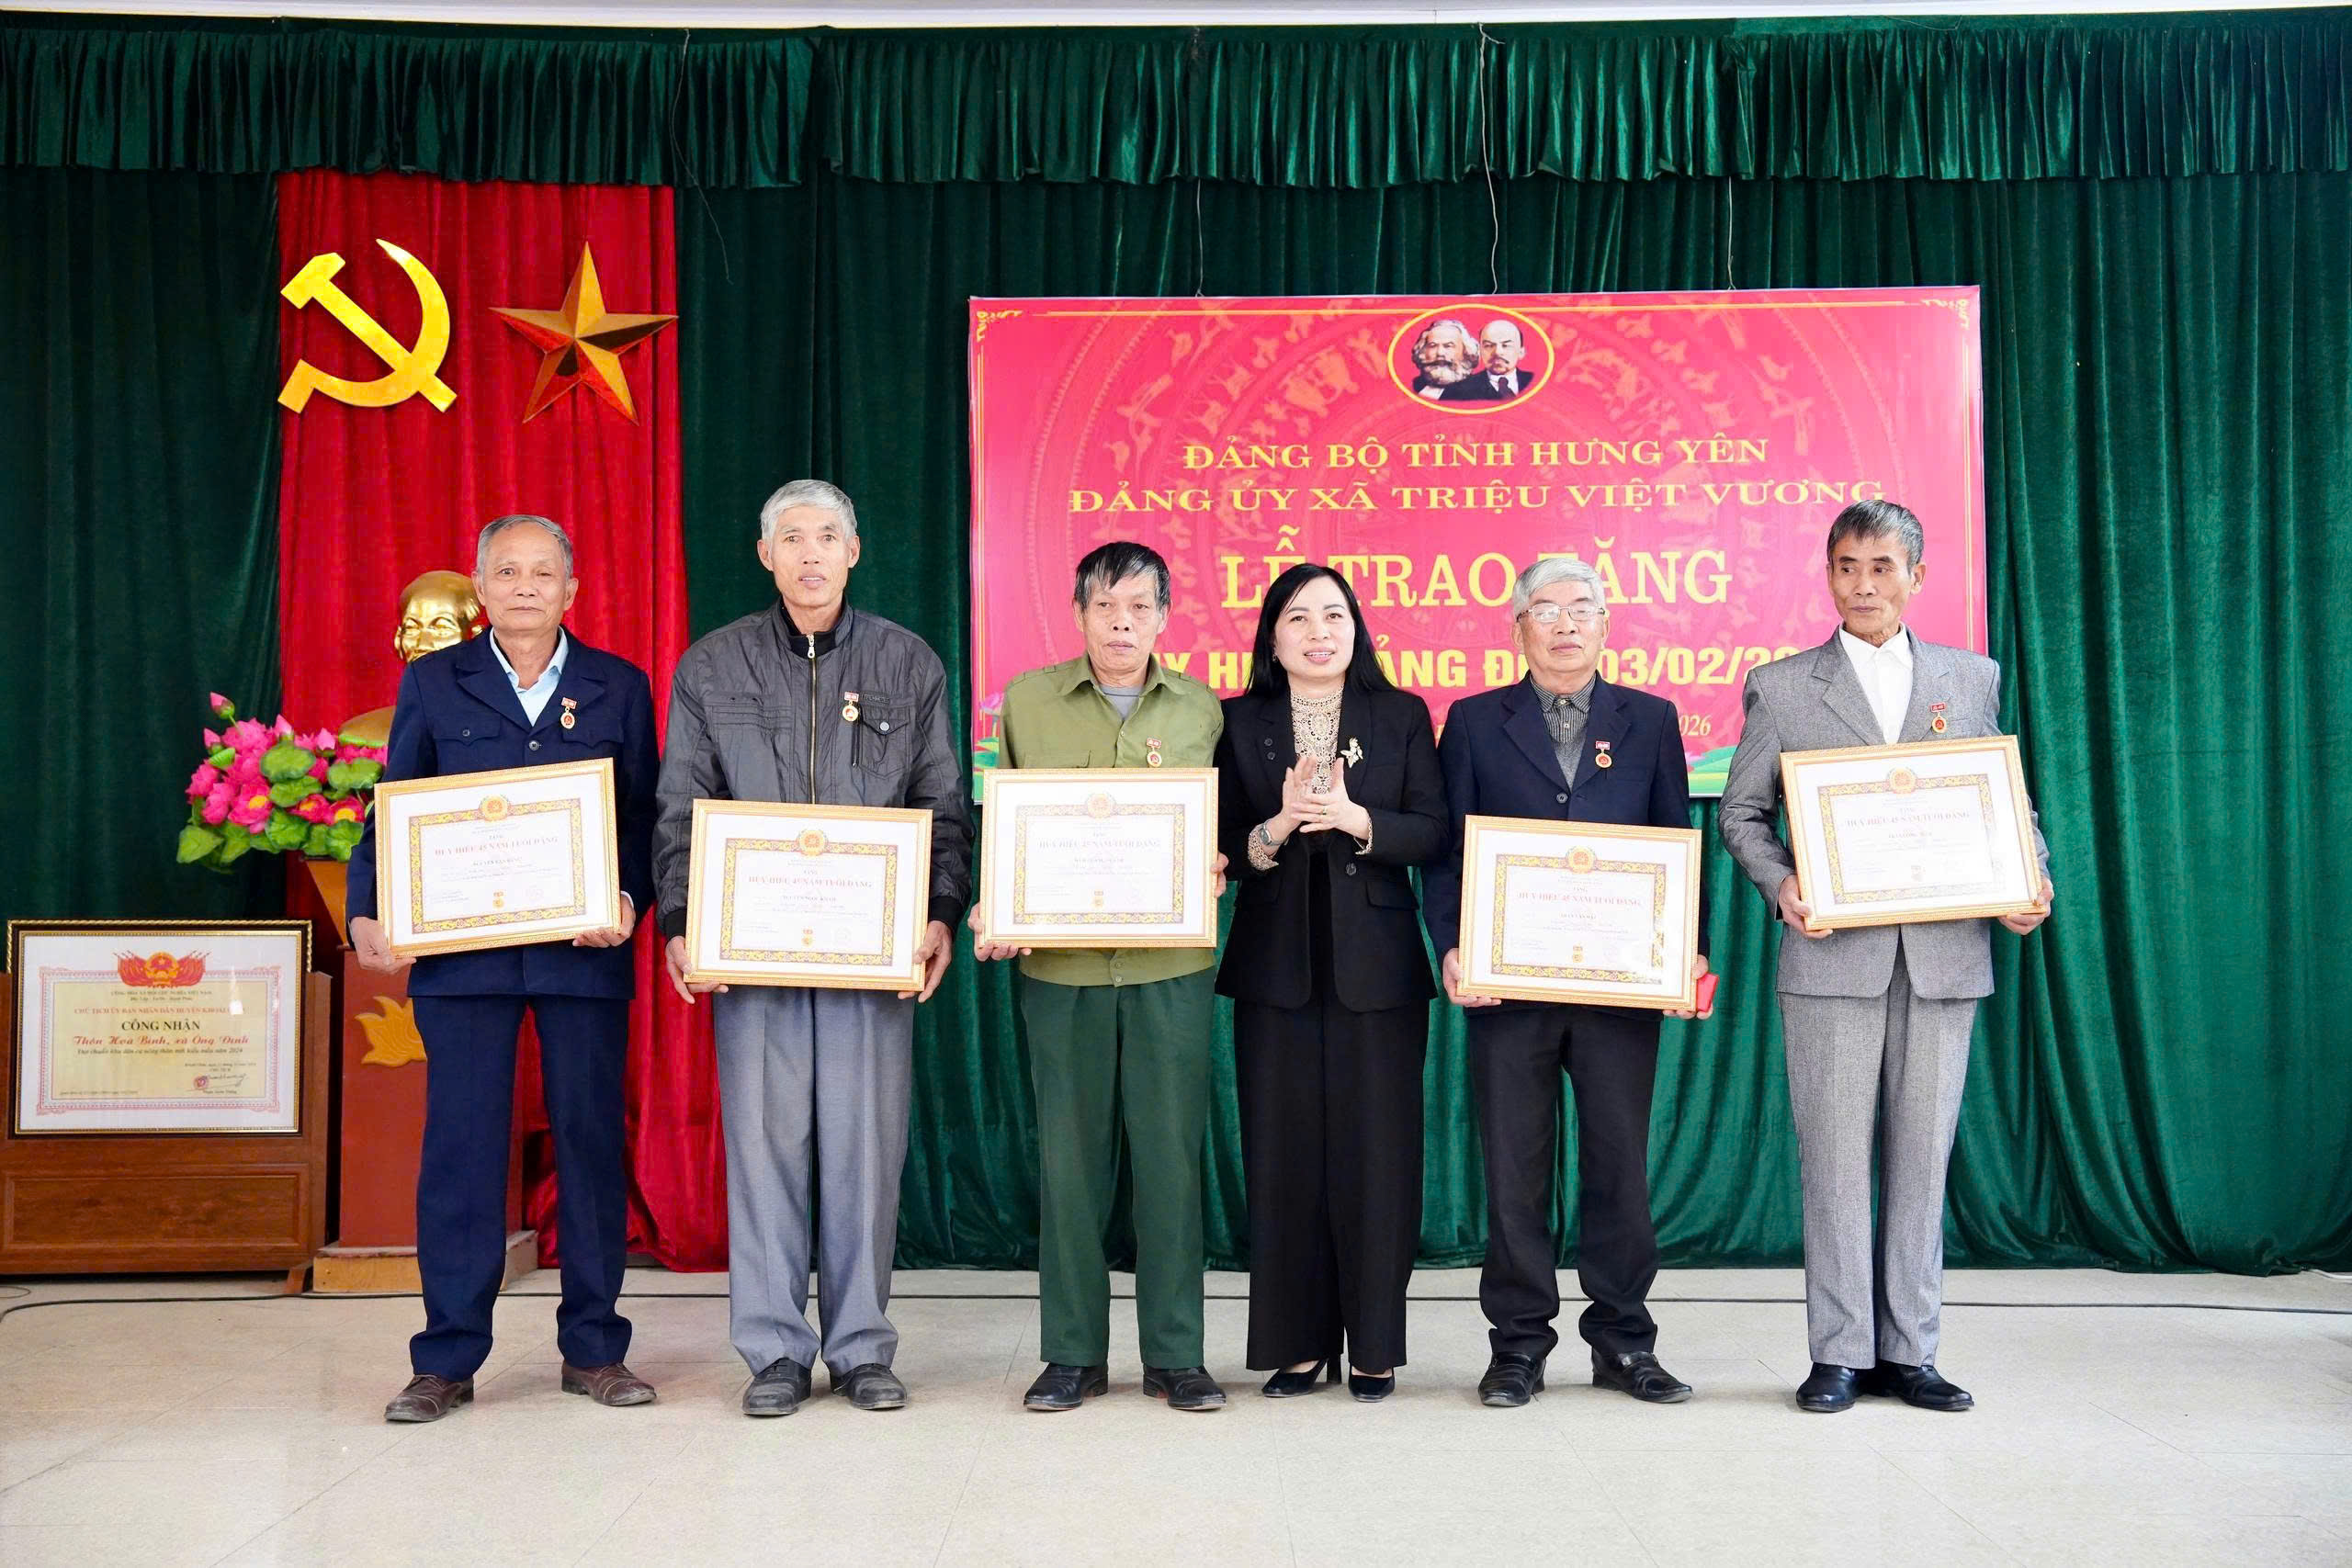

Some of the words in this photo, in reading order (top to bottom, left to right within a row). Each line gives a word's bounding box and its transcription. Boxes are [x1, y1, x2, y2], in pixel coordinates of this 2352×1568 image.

[1183, 434, 1313, 469] ĐẢNG
[1327, 435, 1389, 475] BỘ
[1401, 433, 1515, 468] TỈNH
[1530, 437, 1664, 467] HƯNG
[1675, 432, 1770, 464] YÊN
[1069, 480, 1215, 513] ĐẢNG
[1229, 479, 1298, 512] ỦY
[1308, 480, 1379, 511] XÃ
[1391, 479, 1551, 514] TRIỆU
[1566, 477, 1688, 513] VIỆT
[1702, 479, 1887, 507] VƯƠNG
[1327, 552, 1518, 608] TRAO
[1375, 634, 1467, 688] ẢNG
[1678, 714, 1713, 737] 026
[121, 1018, 160, 1031] CÔNG
[164, 1018, 200, 1032] NHẬN
